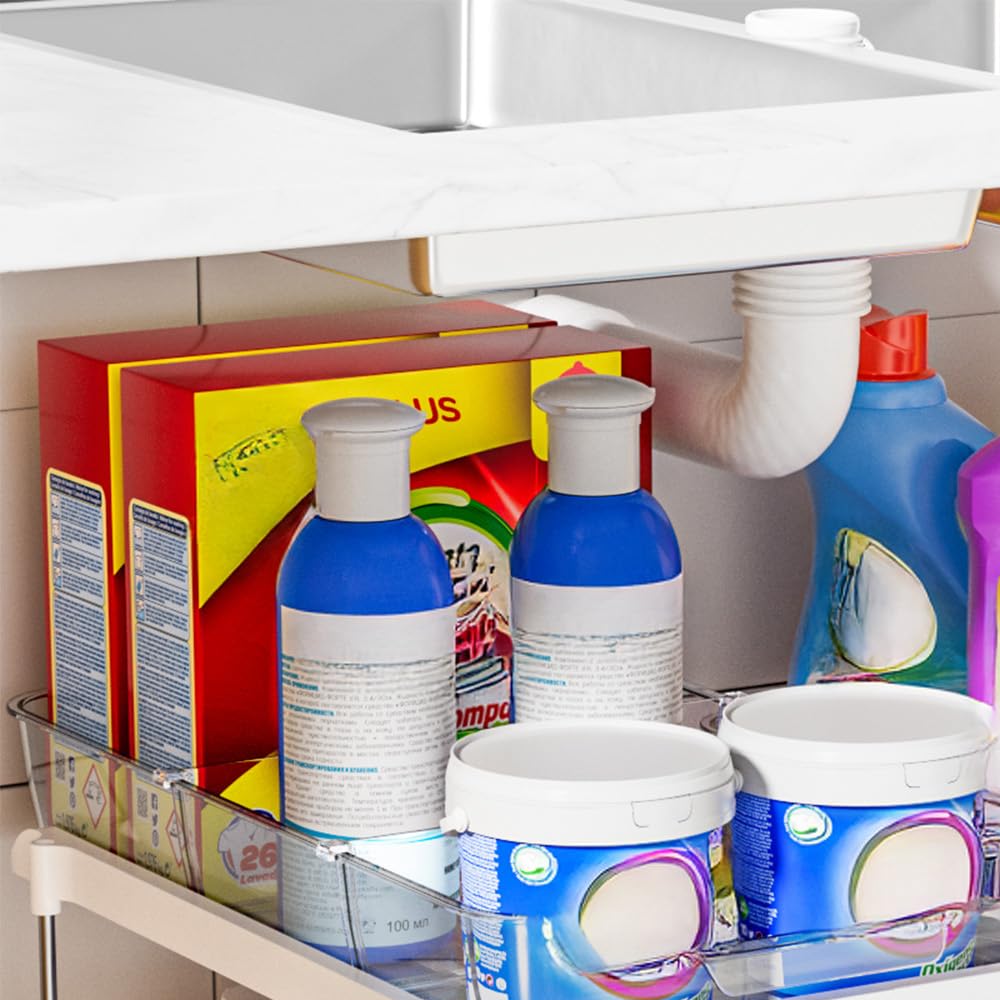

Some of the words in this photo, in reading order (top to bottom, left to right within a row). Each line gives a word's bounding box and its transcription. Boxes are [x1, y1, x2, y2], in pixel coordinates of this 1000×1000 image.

[412, 397, 461, 425] US
[240, 842, 277, 872] 26
[387, 920, 410, 933] 100
[413, 918, 430, 929] мл
